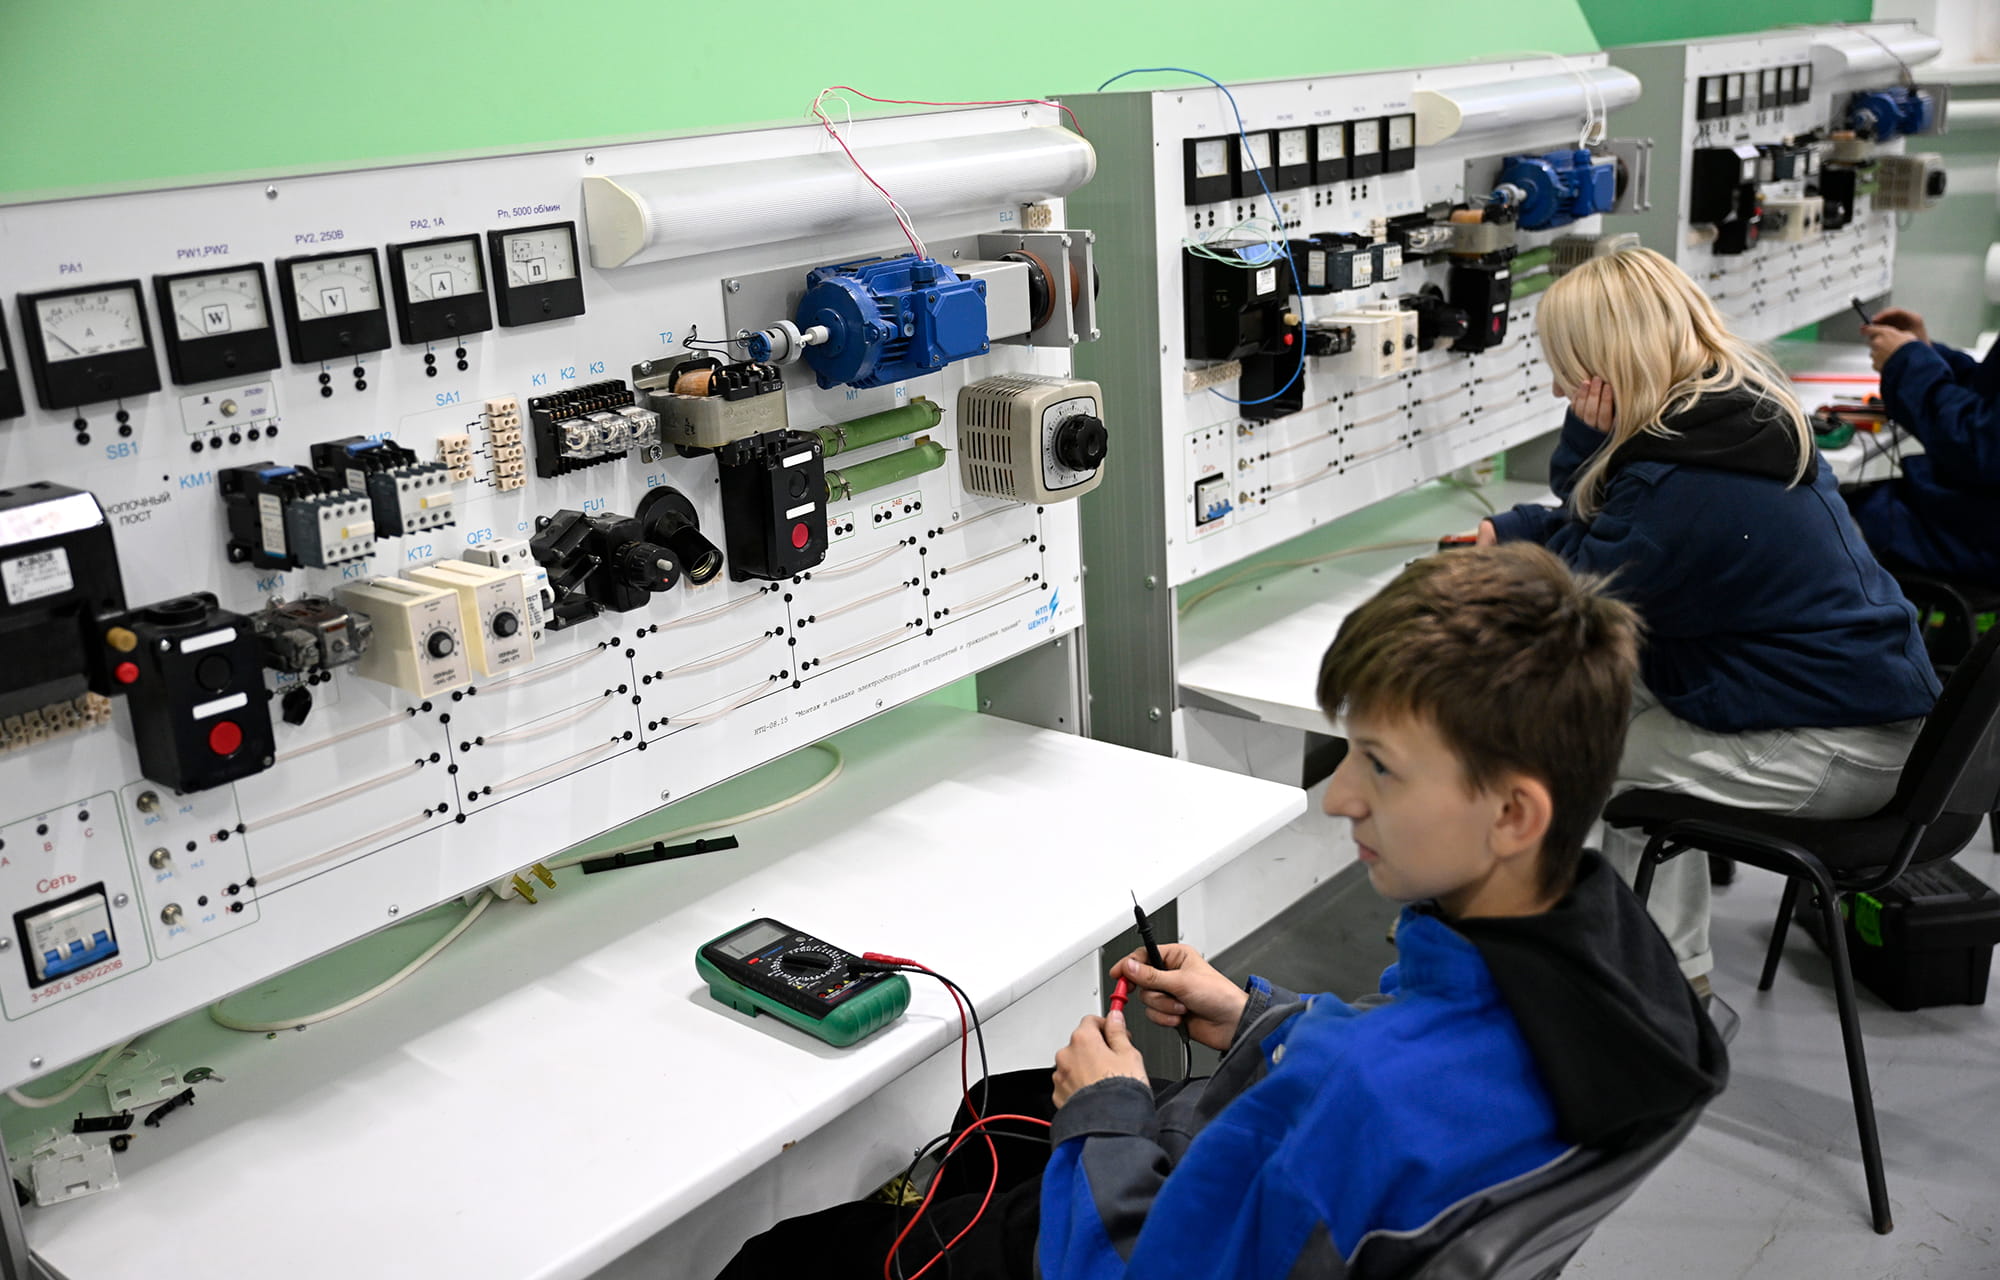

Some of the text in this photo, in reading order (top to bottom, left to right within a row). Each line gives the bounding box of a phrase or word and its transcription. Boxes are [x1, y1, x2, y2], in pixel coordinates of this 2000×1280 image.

[512, 206, 532, 217] 5000
[533, 204, 561, 214] об/мин
[999, 211, 1014, 222] EL2
[320, 229, 345, 242] 250В
[59, 262, 84, 275] PA1
[328, 294, 339, 307] V
[208, 311, 225, 325] W
[659, 331, 673, 345] T2
[560, 366, 576, 380] K2
[589, 361, 605, 375] K3
[532, 373, 548, 387] K1
[435, 391, 462, 407] SA1
[846, 390, 859, 401] M1
[895, 386, 906, 398] R1
[105, 441, 140, 460] SB1
[179, 471, 214, 489] KM1
[647, 473, 667, 488] EL1
[583, 497, 606, 513] FU1
[120, 510, 152, 526] ПОСТ
[466, 528, 493, 546] QF3
[407, 544, 433, 561] KT2
[342, 562, 369, 580] KT1
[256, 574, 286, 593] KK1
[1027, 615, 1049, 631] ЦЕНТР
[36, 873, 77, 894] Сеть
